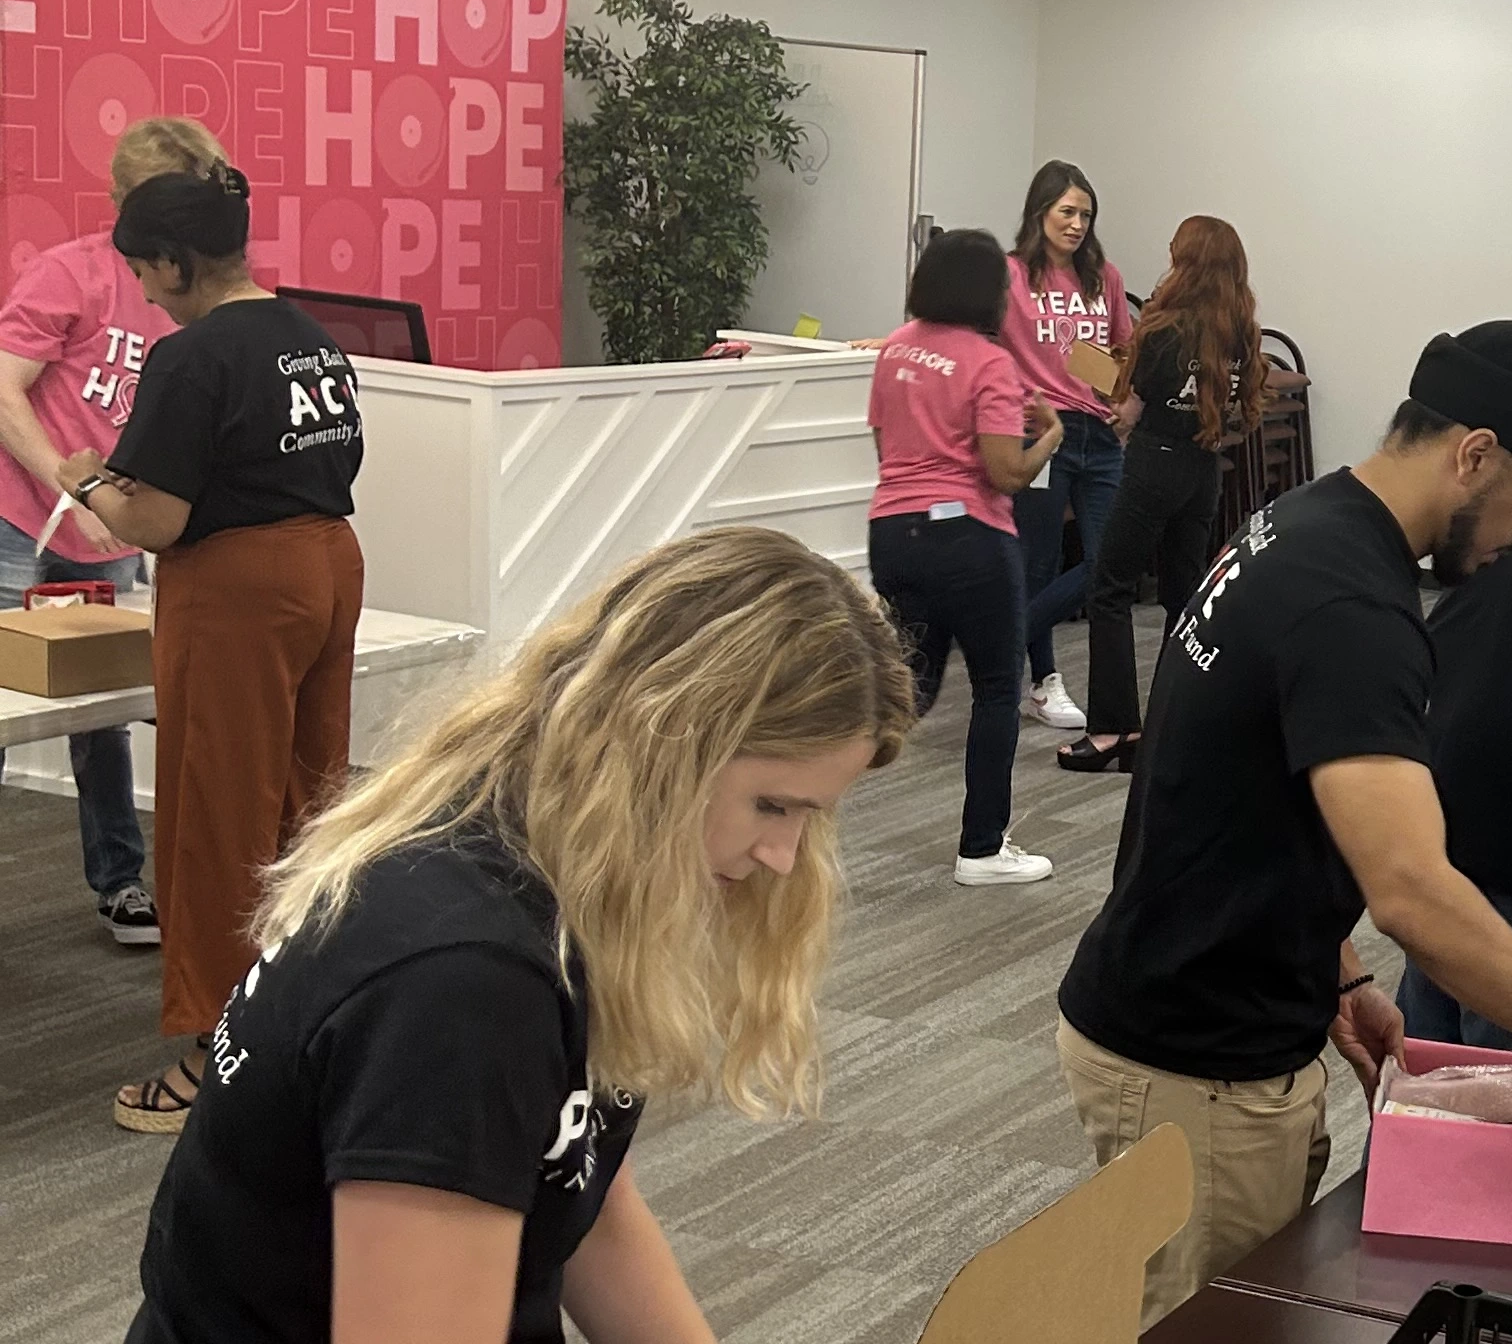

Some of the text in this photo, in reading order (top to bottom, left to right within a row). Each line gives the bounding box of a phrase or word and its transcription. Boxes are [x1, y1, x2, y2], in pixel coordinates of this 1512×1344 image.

[305, 66, 544, 192] HOPE
[1030, 291, 1109, 317] TEAM
[106, 326, 145, 372] TE
[1036, 317, 1109, 355] HOPE
[277, 350, 324, 376] Giving
[1178, 614, 1221, 672] Fund
[213, 1012, 250, 1085] und
